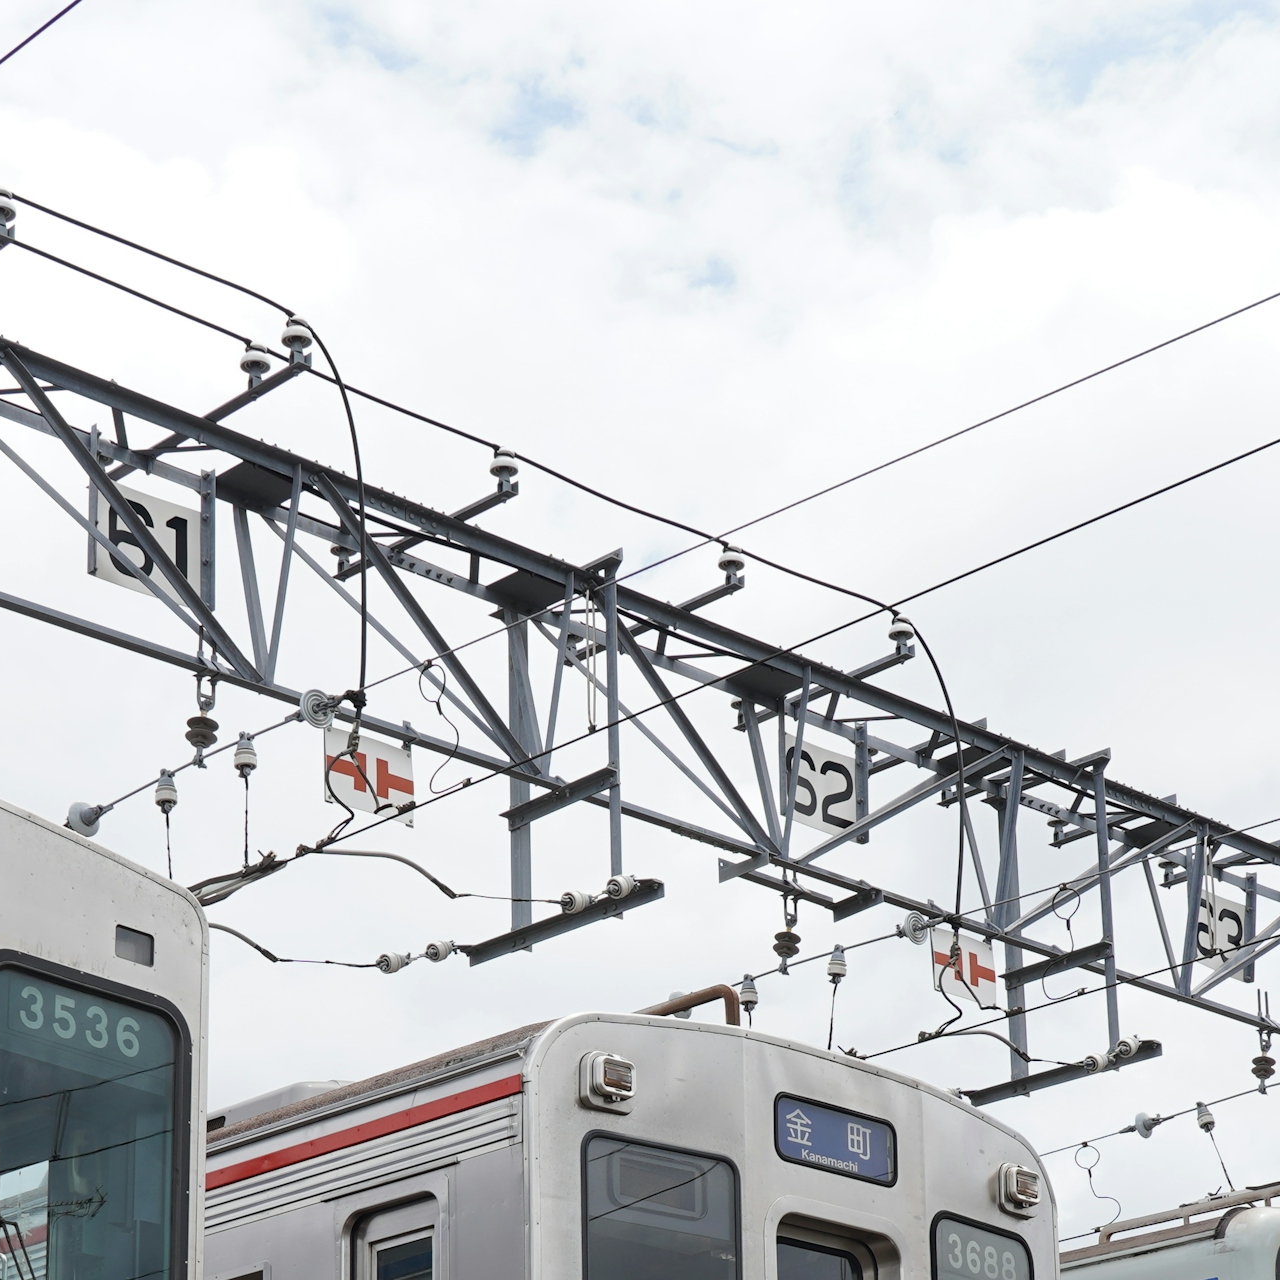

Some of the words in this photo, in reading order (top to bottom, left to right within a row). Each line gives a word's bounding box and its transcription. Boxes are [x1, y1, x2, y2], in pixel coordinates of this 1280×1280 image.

[108, 498, 188, 581] 61
[786, 746, 855, 829] 62
[20, 985, 141, 1058] 3536
[786, 1108, 872, 1160] 金町
[801, 1148, 858, 1172] Kanamachi
